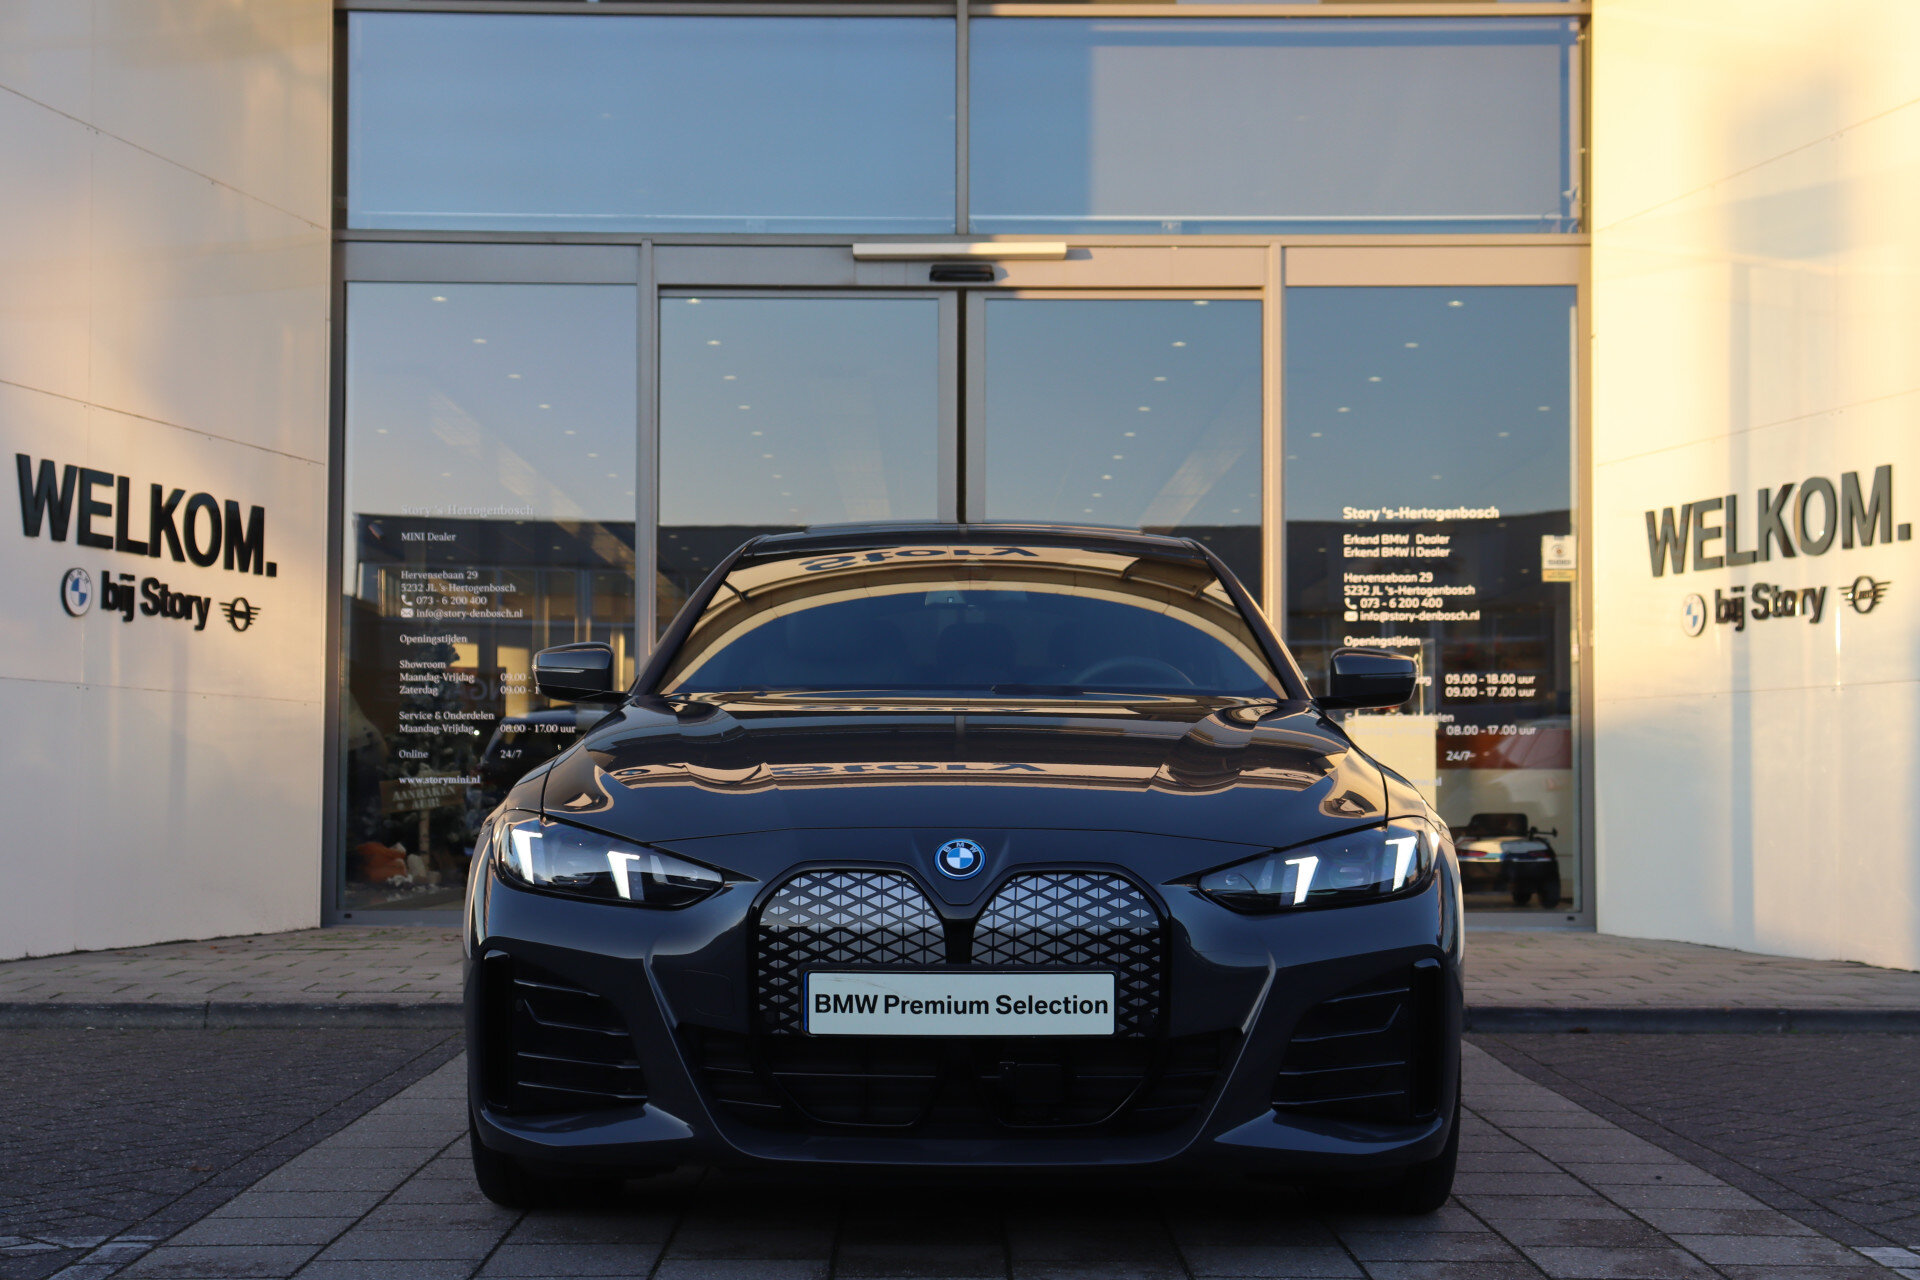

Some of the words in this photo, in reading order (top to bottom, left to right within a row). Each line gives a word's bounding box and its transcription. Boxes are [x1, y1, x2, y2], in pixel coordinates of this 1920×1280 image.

[16, 453, 277, 578] WELKOM.
[402, 504, 431, 517] Story
[1343, 507, 1380, 521] Story
[1382, 506, 1500, 521] 's-Hertogenbosch
[1645, 464, 1912, 577] WELKOM.
[402, 532, 425, 541] MINI
[427, 532, 456, 541] Dealer
[1343, 534, 1380, 545] Erkend
[1381, 534, 1410, 545] BMW
[1415, 534, 1450, 545] Dealer
[1343, 547, 1380, 558] Erkend
[1381, 547, 1409, 558] BMW
[1415, 546, 1450, 558] Dealer
[401, 571, 464, 580] Hervensebaan
[467, 571, 478, 580] 29
[1343, 572, 1418, 583] Hervensebaan
[1419, 572, 1433, 583] 29
[401, 584, 424, 592] 5232
[426, 584, 437, 593] JL
[1344, 585, 1370, 596] 5232
[1371, 585, 1383, 596] JL
[1385, 584, 1476, 597] 's-Hertogenbosch
[101, 570, 135, 623] bij
[139, 577, 212, 632] Story
[416, 596, 434, 605] 073
[442, 596, 448, 605] 6
[450, 596, 468, 605] 200
[469, 596, 488, 605] 400
[1359, 598, 1380, 608] 073
[1388, 598, 1397, 608] 6
[1398, 598, 1420, 608] 200
[1420, 598, 1443, 608] 400
[1715, 585, 1745, 632] bij
[1751, 582, 1828, 624] Story
[416, 609, 523, 620] info@story-denbosch.nl
[1359, 610, 1480, 623] info@story-denbosch.nl
[400, 634, 468, 645] Openingstijden
[1343, 635, 1421, 648] Openingstijden
[400, 660, 446, 669] Showroom
[400, 673, 475, 684] Maandag-Vrijdag
[500, 673, 526, 682] 09.00
[1445, 673, 1478, 684] 09.00
[1485, 673, 1516, 684] 18.00
[1517, 676, 1535, 684] uur
[400, 686, 439, 697] Zaterdag
[500, 686, 526, 695] 09.00
[1445, 686, 1478, 697] 09.00
[1518, 689, 1536, 697] uur
[399, 711, 431, 720] Service
[434, 711, 442, 720] &
[443, 711, 495, 721] Onderdelen
[399, 725, 475, 735] Maandag-Vrijdag
[535, 725, 558, 734] 17.00
[560, 726, 576, 734] uur
[1446, 725, 1479, 735] 08.00
[1518, 727, 1536, 735] uur
[399, 750, 428, 759] Online
[500, 750, 522, 760] 24/7
[1446, 751, 1470, 761] 24/7
[399, 776, 480, 787] www.storymini.nl
[942, 841, 979, 853] BMW
[814, 994, 878, 1014] BMW
[884, 995, 989, 1014] Premium
[995, 994, 1109, 1014] Selection
